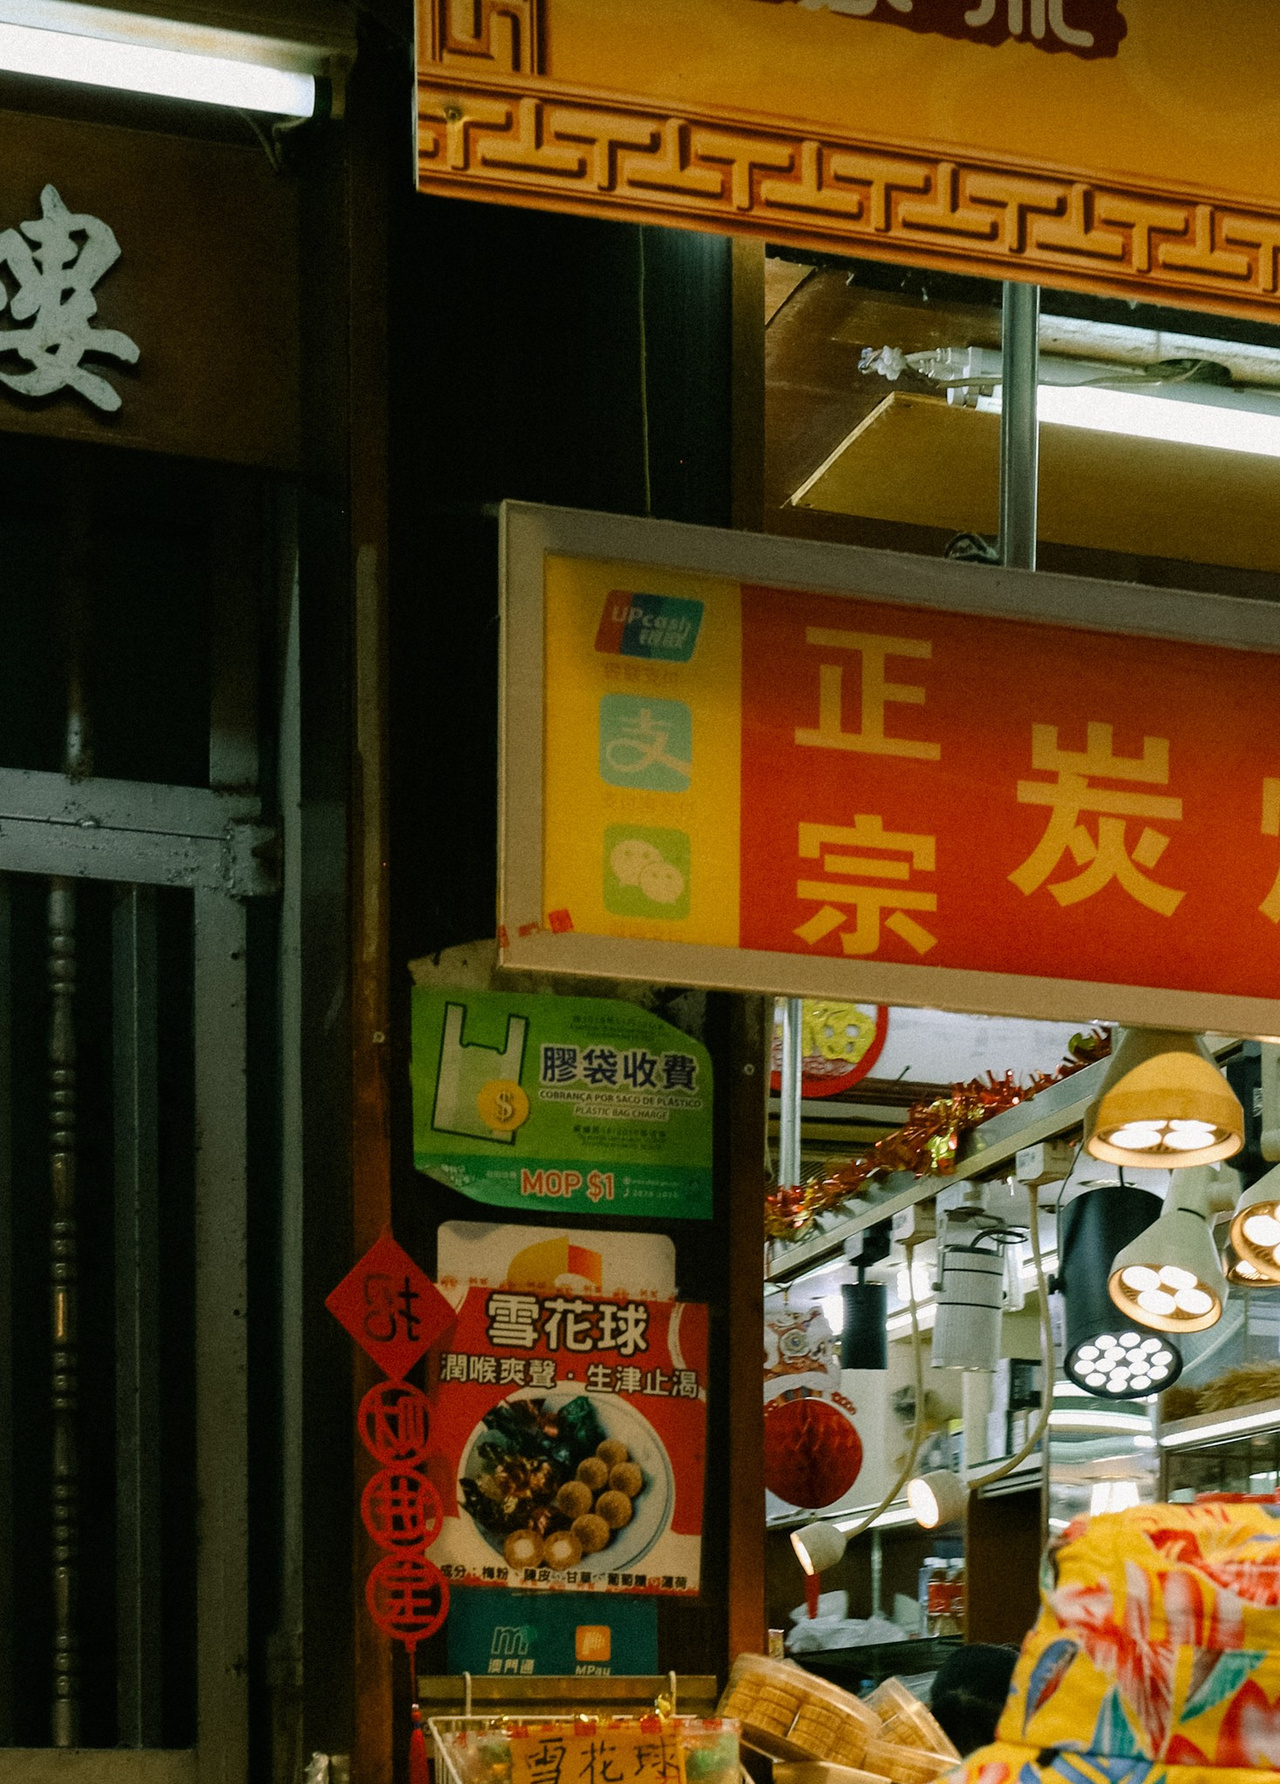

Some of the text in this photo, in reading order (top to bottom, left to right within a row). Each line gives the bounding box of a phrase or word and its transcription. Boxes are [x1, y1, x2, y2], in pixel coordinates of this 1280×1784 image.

[793, 626, 942, 956] 正宗
[542, 1046, 697, 1091] 膠袋收費
[540, 1090, 591, 1103] COBRANÇA
[594, 1092, 614, 1103] POR
[616, 1094, 640, 1105] SACO
[642, 1095, 655, 1106] DE
[575, 1106, 668, 1120] PLASTIC BAG CHARGE
[521, 1168, 583, 1198] MOP
[587, 1170, 615, 1203] $1
[488, 1294, 650, 1356] 雪花球
[575, 1665, 611, 1677] MPay
